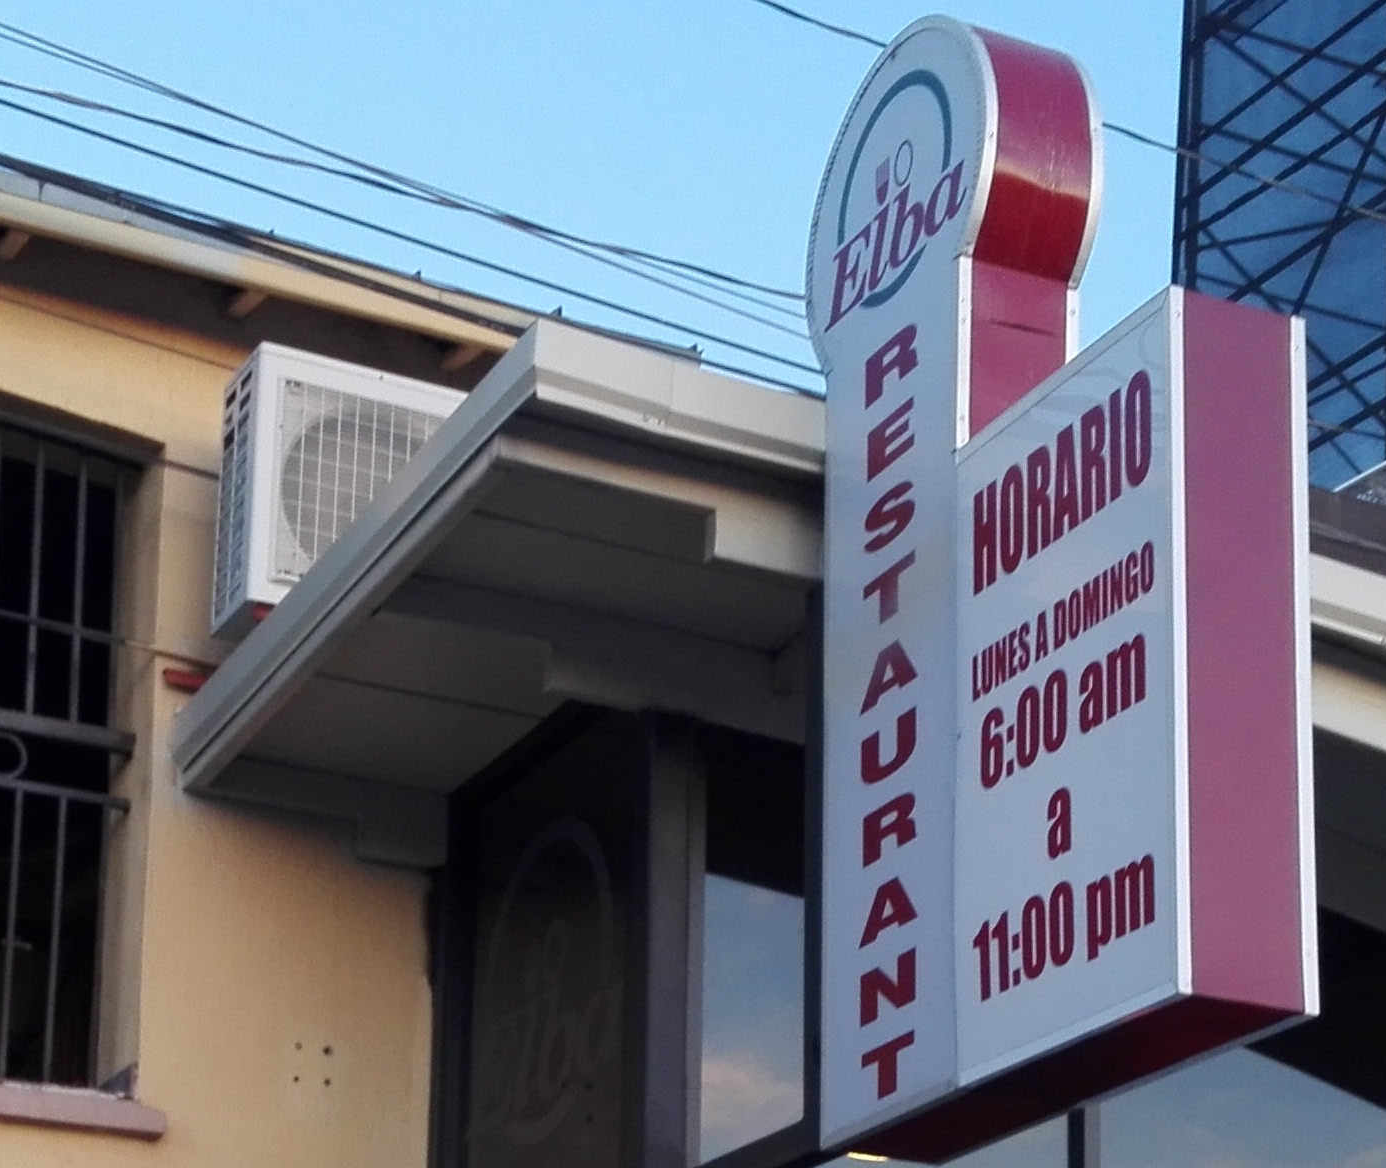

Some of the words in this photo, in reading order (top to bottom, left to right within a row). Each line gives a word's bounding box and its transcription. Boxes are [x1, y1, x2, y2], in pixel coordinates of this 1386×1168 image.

[824, 158, 968, 333] Elba
[972, 369, 1154, 596] HORARIO
[971, 620, 1032, 703] LUNES
[1034, 608, 1049, 664] A
[1053, 539, 1156, 652] DOMINGO
[858, 323, 919, 1101] RESTAURANT
[980, 668, 1068, 789] 6:00
[1078, 632, 1147, 735] am
[1045, 786, 1073, 860] a
[971, 881, 1075, 1002] 11:00
[1086, 853, 1157, 963] pm
